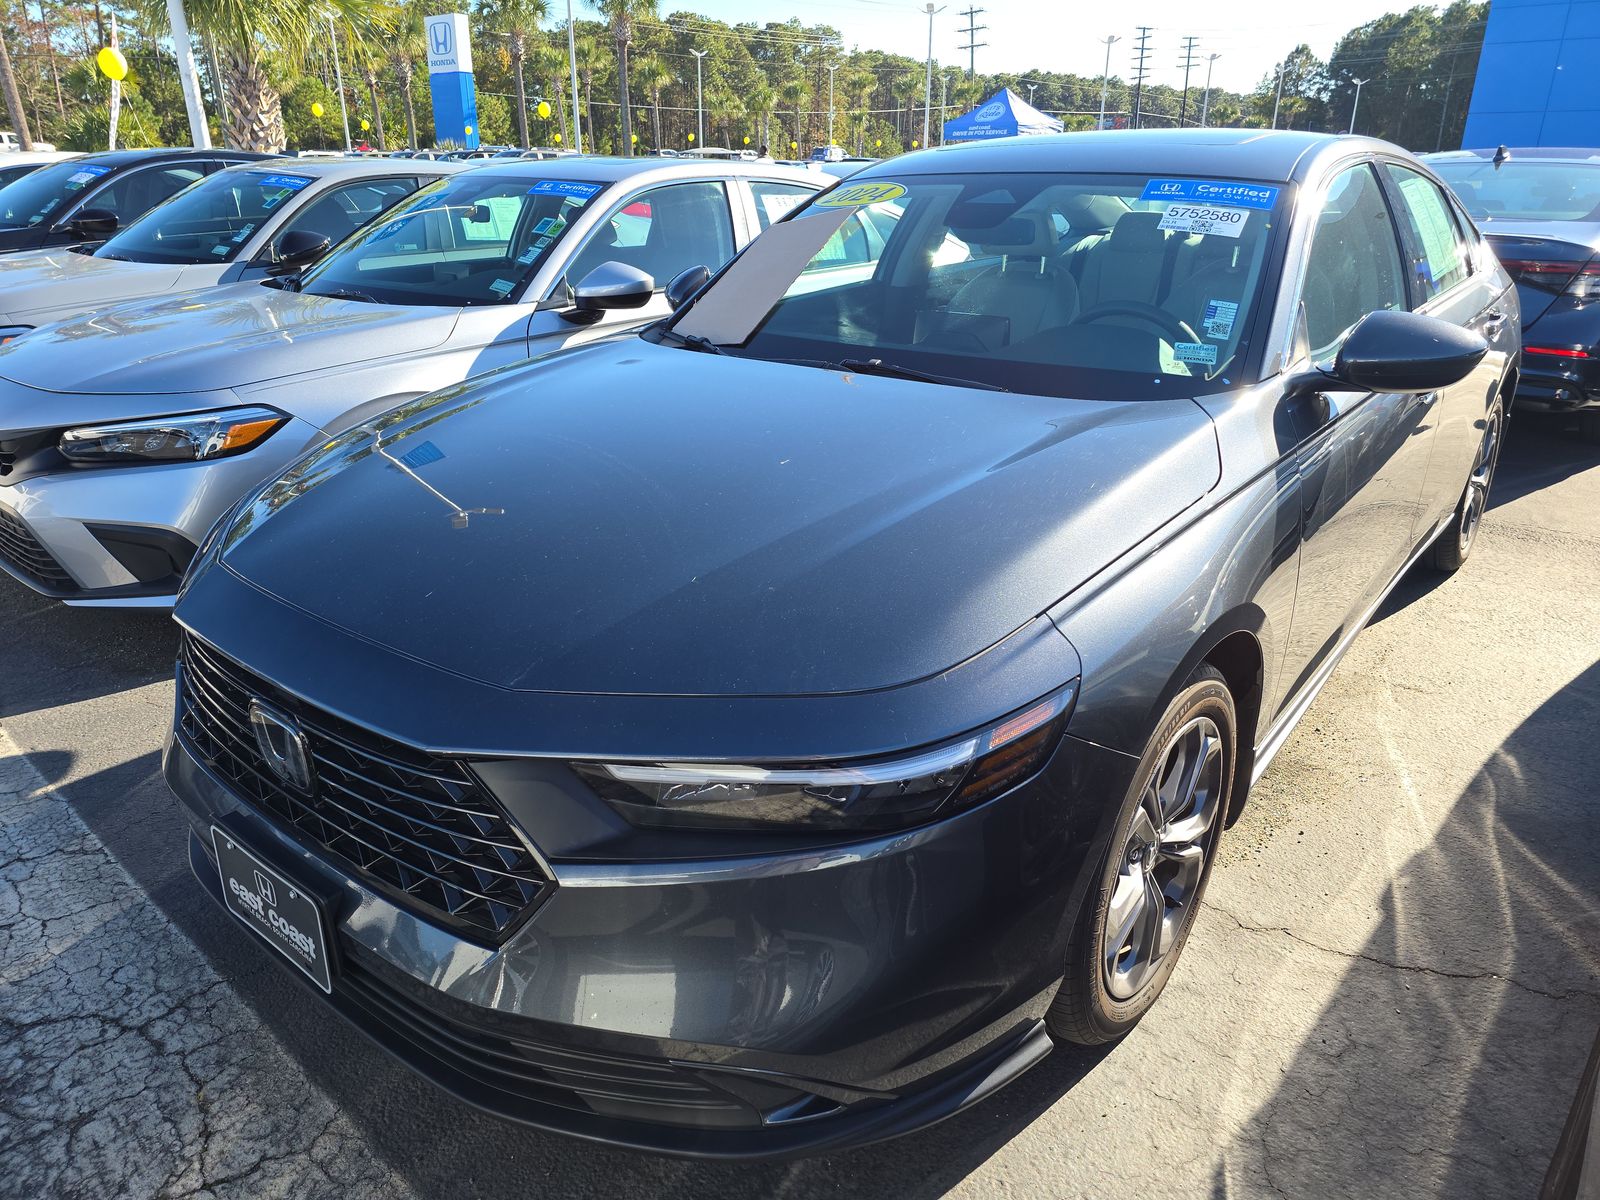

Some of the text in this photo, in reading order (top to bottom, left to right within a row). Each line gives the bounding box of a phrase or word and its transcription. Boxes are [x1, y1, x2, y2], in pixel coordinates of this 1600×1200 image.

[430, 59, 456, 67] HONDA
[559, 184, 596, 193] Certified
[821, 186, 897, 204] 2024
[1197, 184, 1270, 198] Certified
[1195, 191, 1268, 203] Pre-Owned
[1168, 207, 1241, 224] 5752580
[1176, 344, 1217, 352] Certified
[229, 877, 317, 959] east coast
[273, 926, 289, 944] SOUTH
[289, 940, 313, 964] CAROLINA
